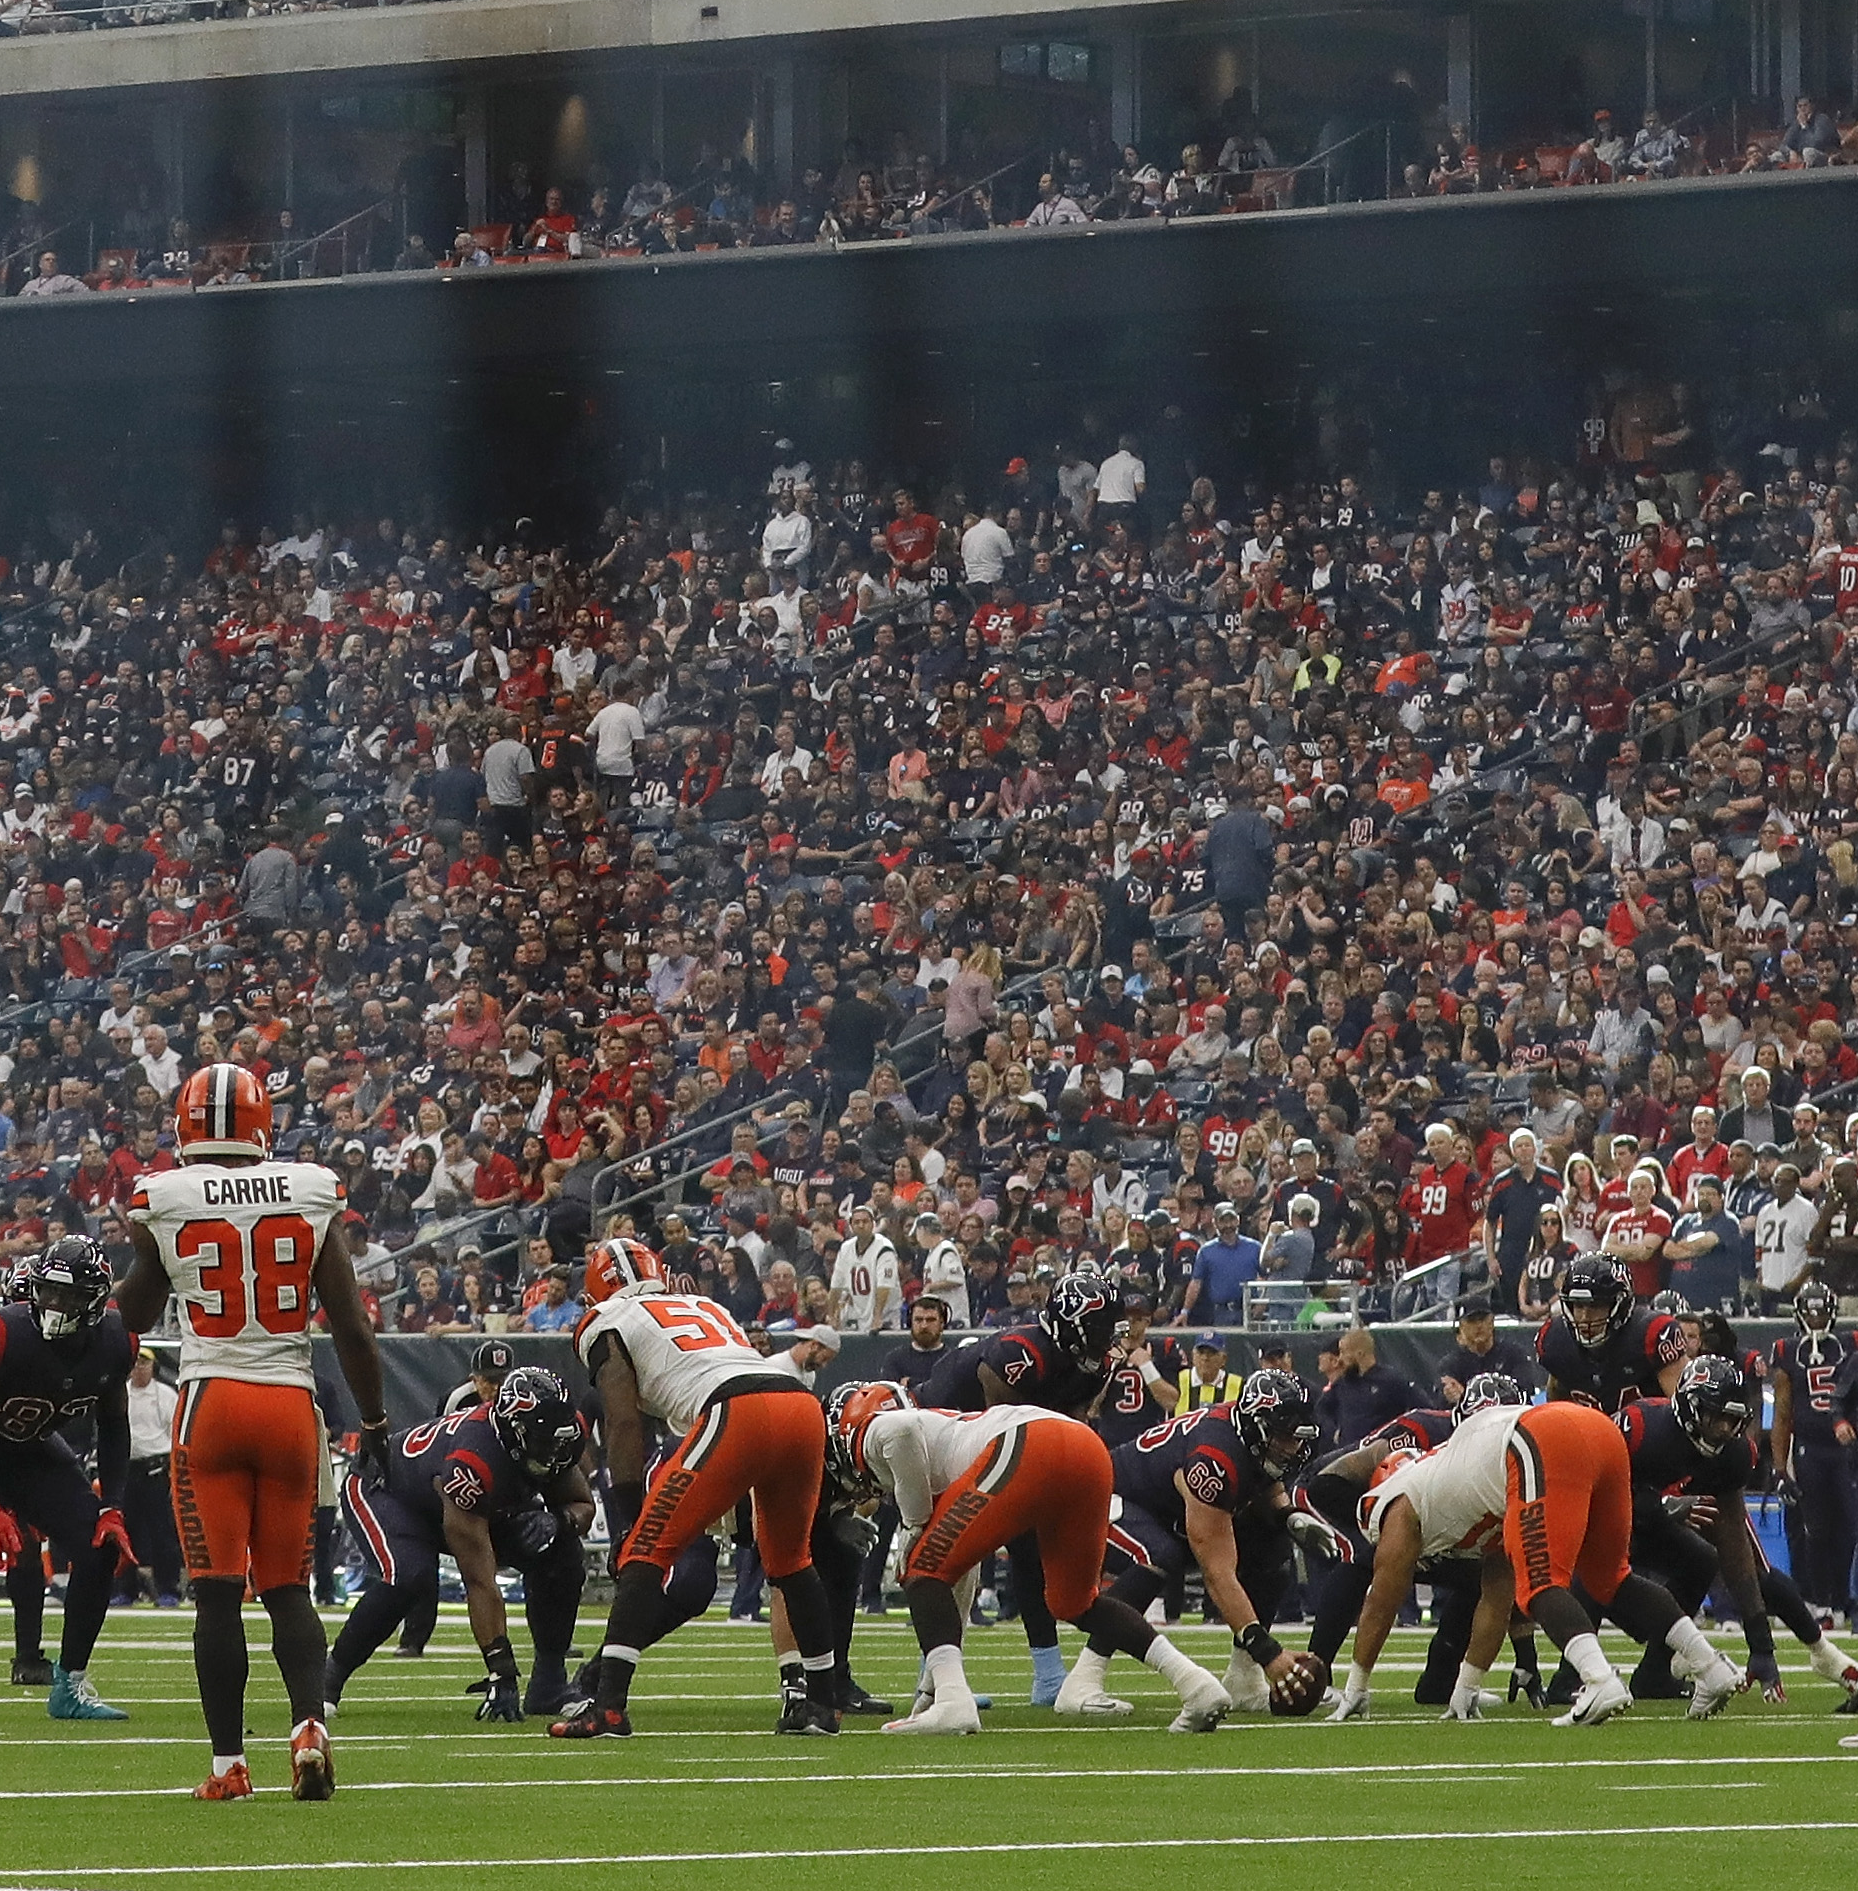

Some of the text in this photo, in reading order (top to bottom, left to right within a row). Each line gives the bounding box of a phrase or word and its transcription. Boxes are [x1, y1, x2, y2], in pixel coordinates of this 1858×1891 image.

[931, 567, 948, 584] 99
[1840, 567, 1857, 591] 10
[1411, 591, 1421, 610] 4
[1224, 613, 1241, 632] 99
[542, 740, 556, 768] 6
[223, 759, 255, 784] 87
[1181, 870, 1205, 891] 75
[1209, 1129, 1238, 1157] 99
[204, 1175, 291, 1205] CARRIE
[1421, 1185, 1446, 1213] 99
[839, 1194, 854, 1219] 4
[1762, 1221, 1787, 1253] 21
[176, 1215, 315, 1337] 38
[850, 1268, 871, 1298] 10
[1659, 1329, 1688, 1364] 84
[1006, 1361, 1024, 1385] 4
[1115, 1369, 1141, 1412] 3
[1807, 1366, 1836, 1412] 5
[452, 1465, 484, 1509] 75
[1188, 1462, 1223, 1502] 66
[171, 1447, 212, 1569] BROWNS
[633, 1472, 693, 1560] BROWNS
[911, 1493, 989, 1574] BROWNS
[1520, 1498, 1548, 1590] BROWNS
